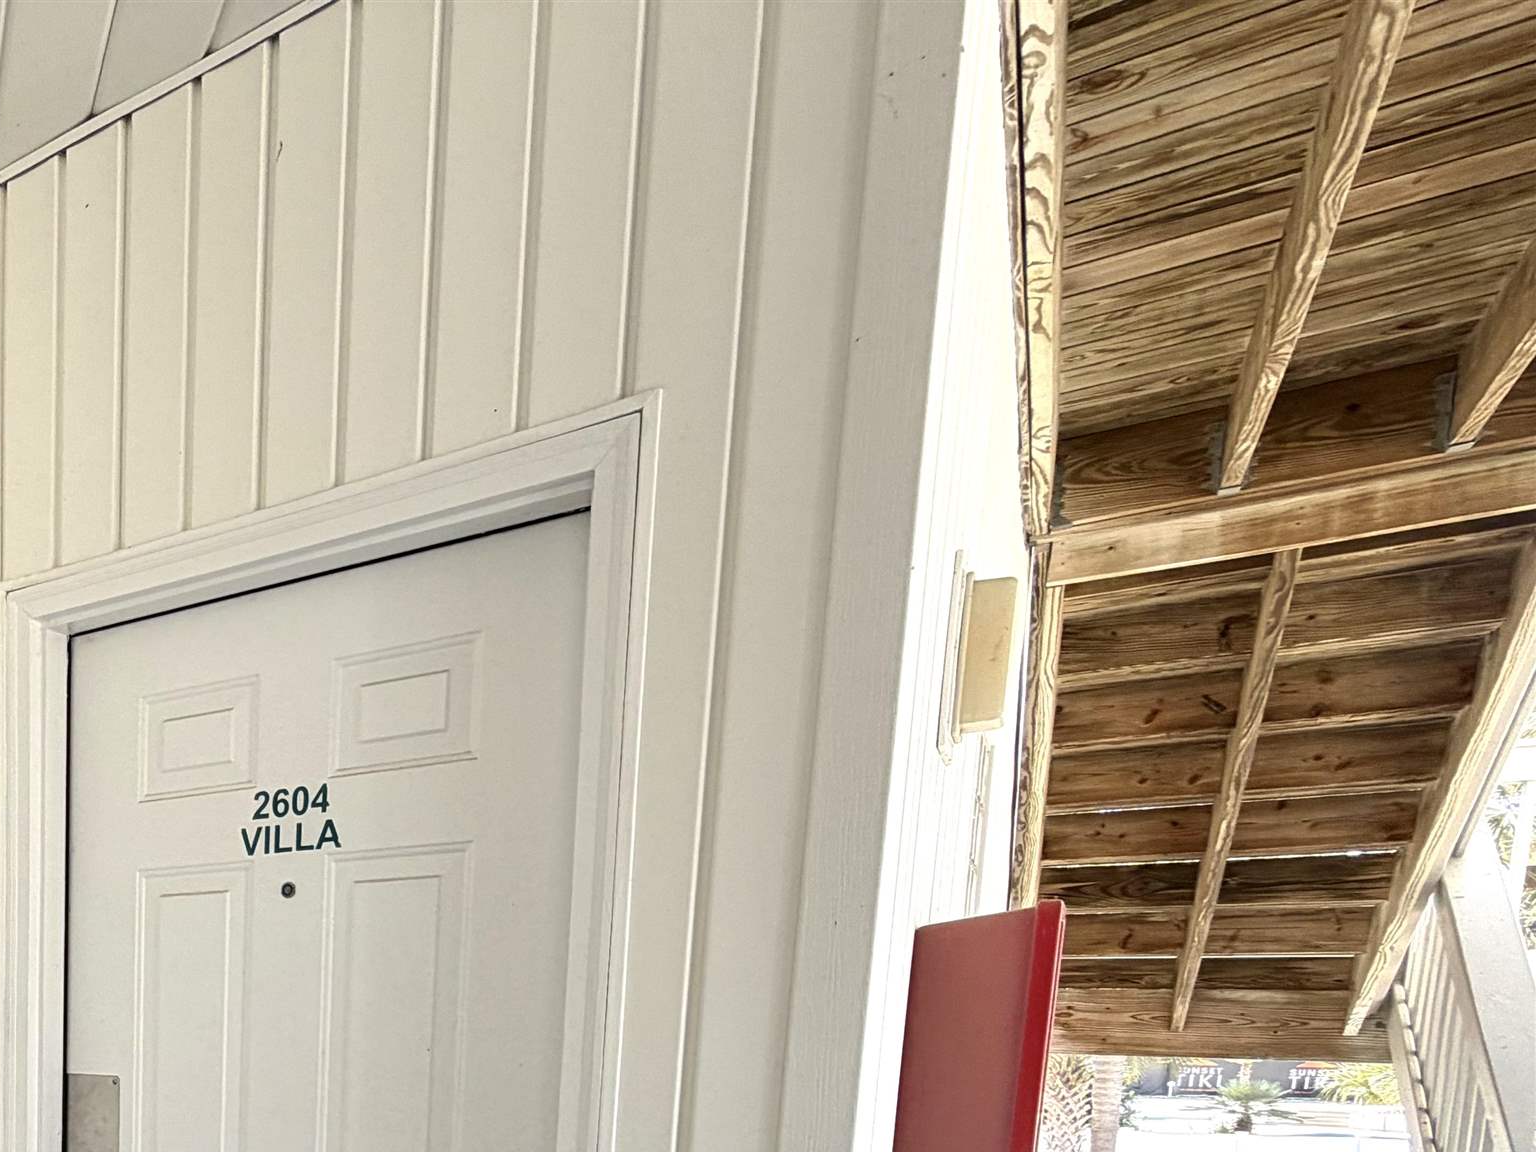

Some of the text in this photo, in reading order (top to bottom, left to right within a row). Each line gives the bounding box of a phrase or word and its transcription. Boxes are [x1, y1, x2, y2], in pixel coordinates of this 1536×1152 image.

[252, 783, 330, 820] 2604
[241, 819, 341, 856] VILLA
[1288, 1076, 1329, 1090] TIK
